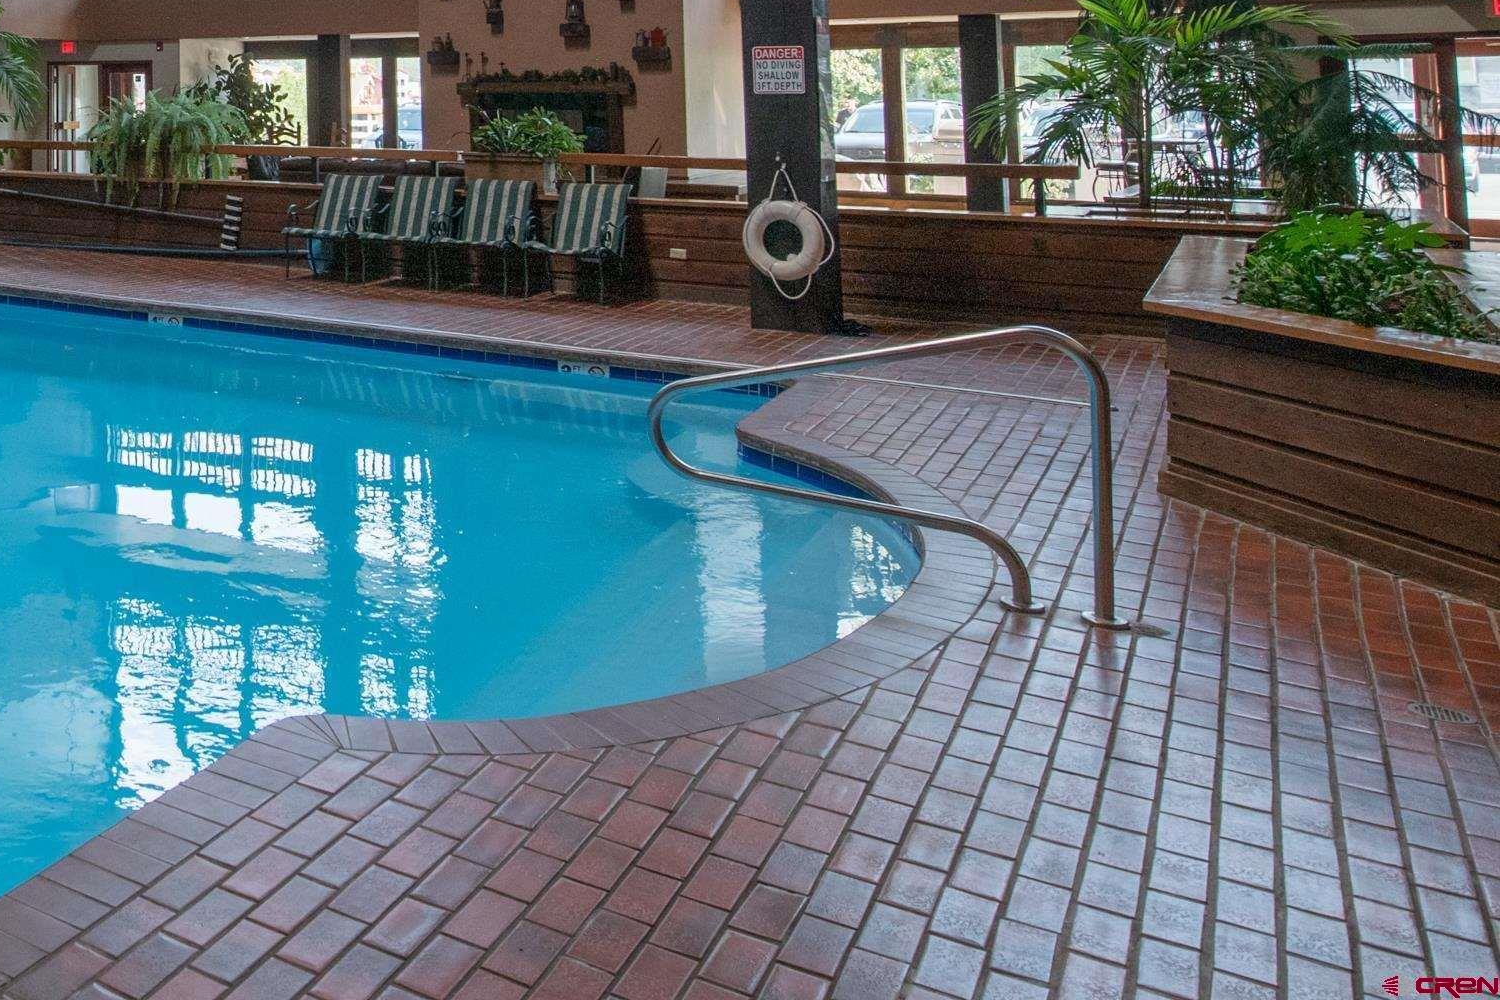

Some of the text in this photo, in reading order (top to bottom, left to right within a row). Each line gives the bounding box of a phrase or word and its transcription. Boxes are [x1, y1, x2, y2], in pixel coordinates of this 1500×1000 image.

[754, 48, 802, 59] DANGER:
[756, 60, 801, 69] NO DIVING
[758, 71, 799, 80] SHALLOW
[774, 81, 803, 91] DEPTH
